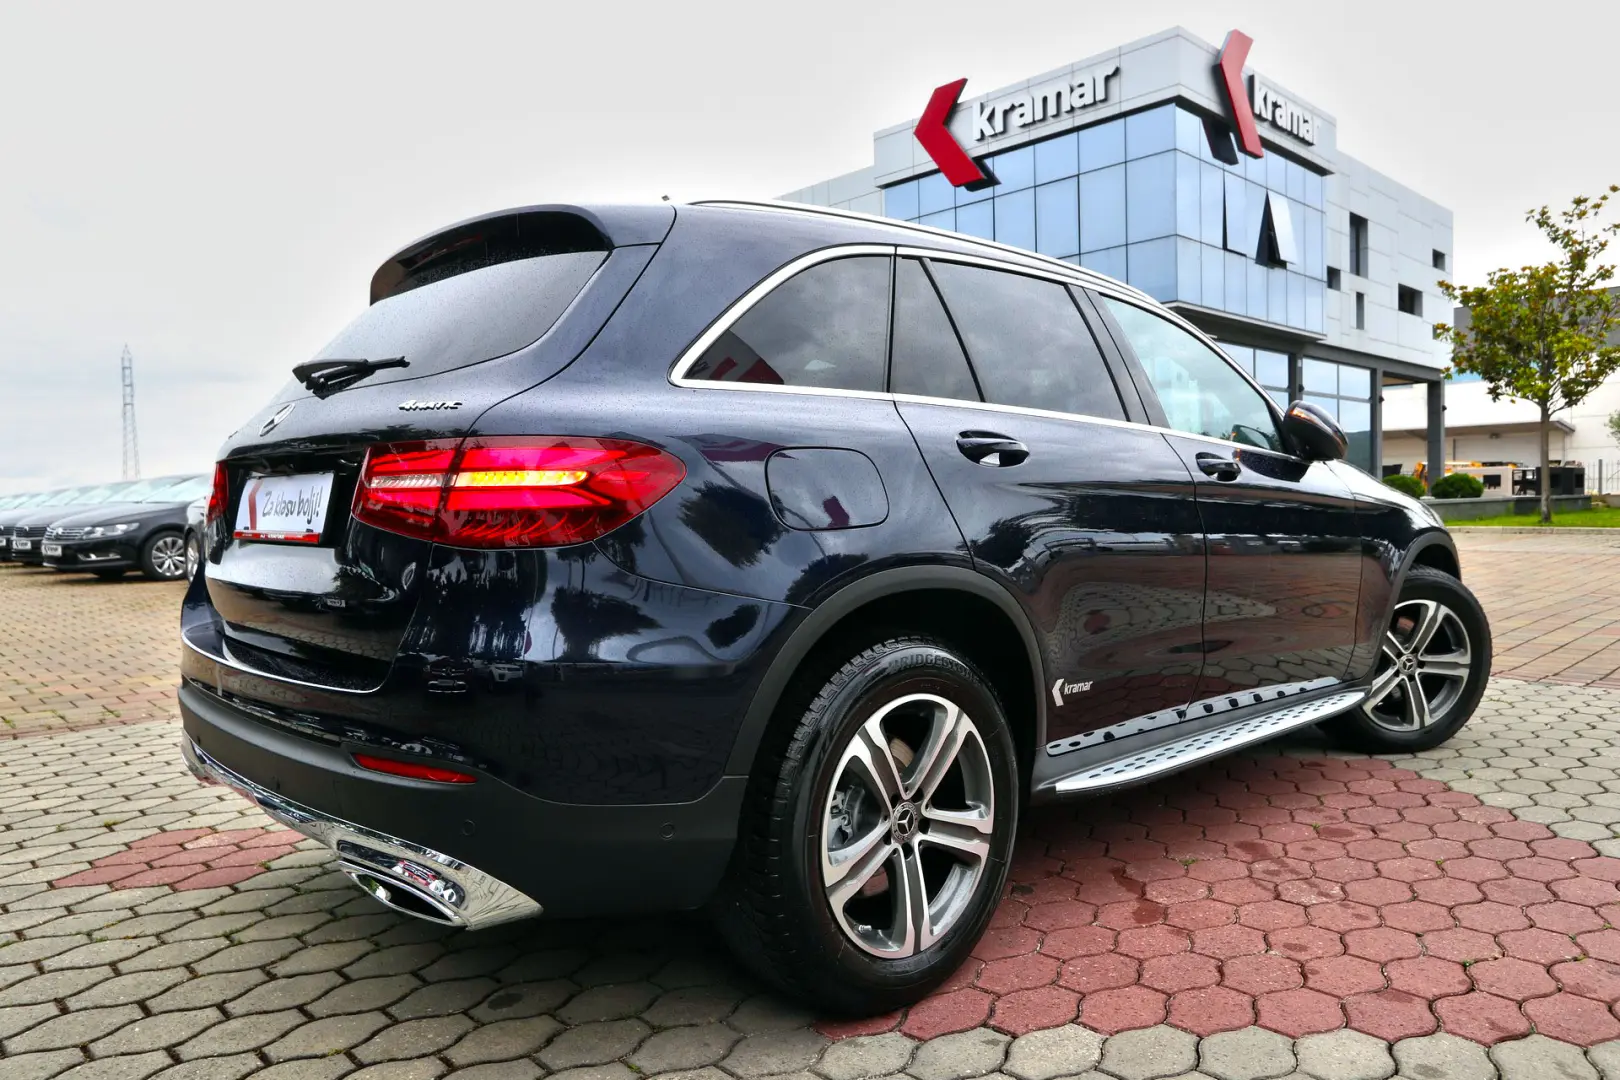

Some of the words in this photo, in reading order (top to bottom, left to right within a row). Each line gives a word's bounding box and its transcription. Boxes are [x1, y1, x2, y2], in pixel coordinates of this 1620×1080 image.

[972, 65, 1120, 141] kramar
[262, 490, 275, 518] Za
[1064, 681, 1094, 695] kramar
